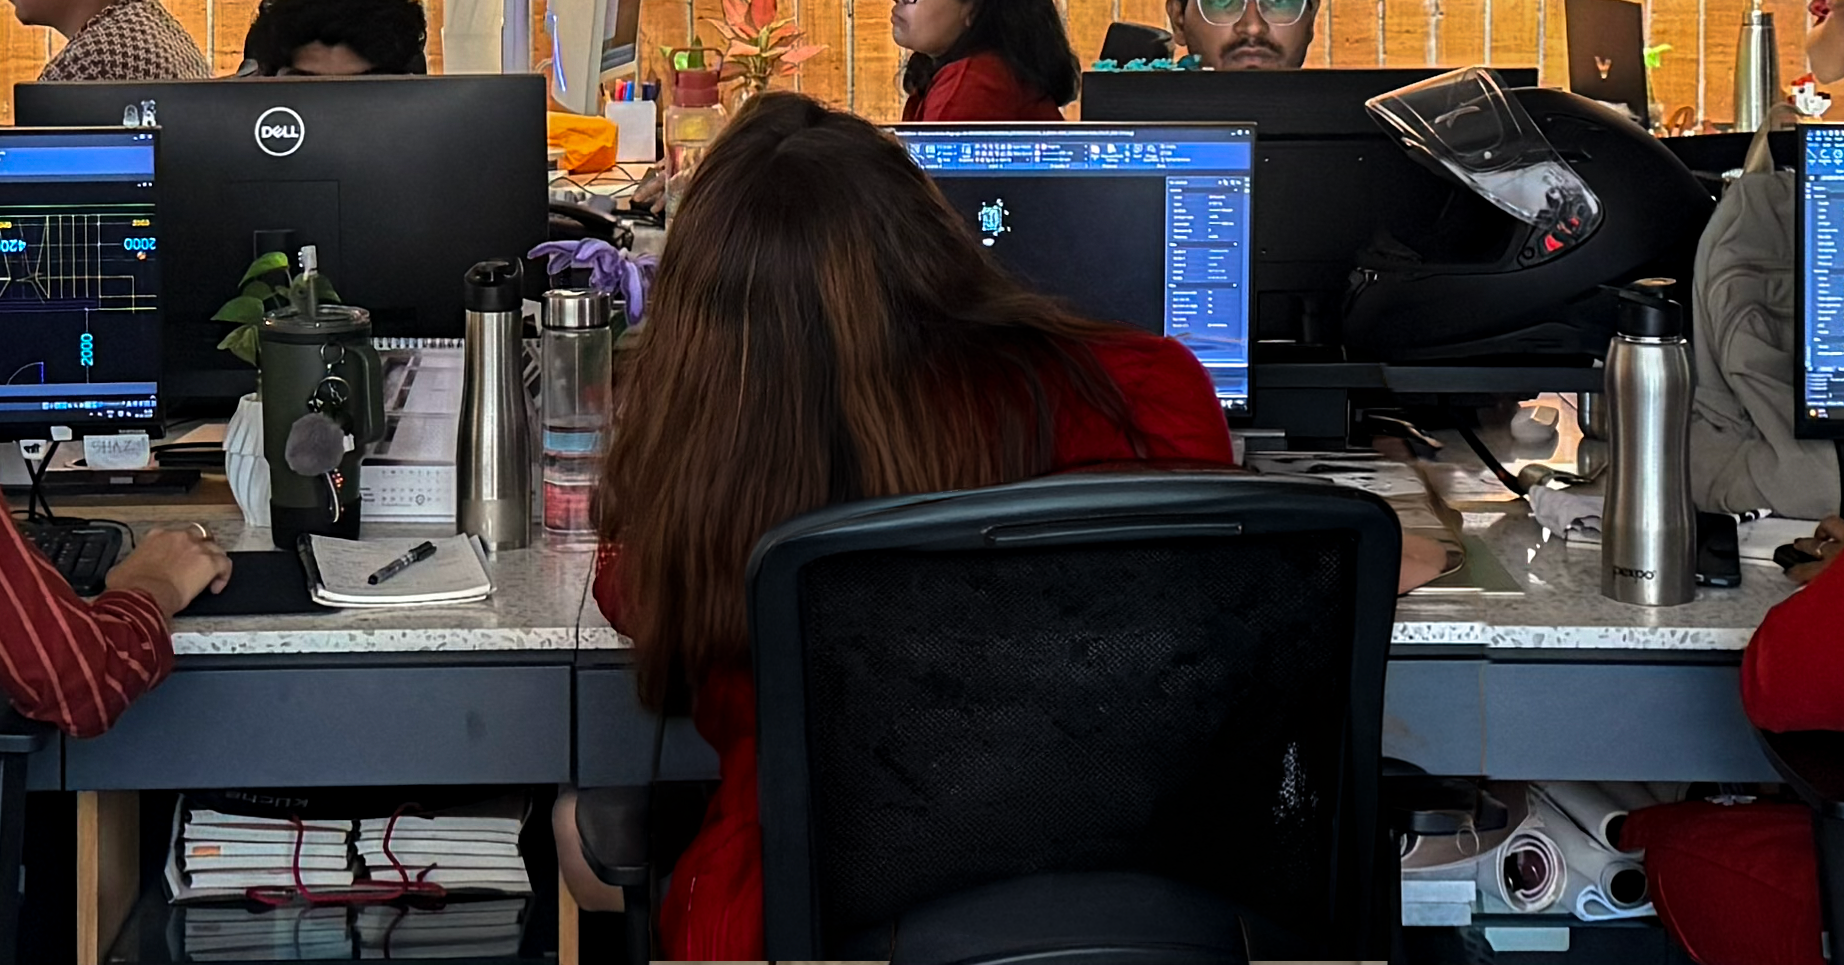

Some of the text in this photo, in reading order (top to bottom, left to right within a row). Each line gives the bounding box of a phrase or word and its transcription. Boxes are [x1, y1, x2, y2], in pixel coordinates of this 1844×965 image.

[261, 125, 299, 139] DELL
[123, 237, 156, 251] 2000
[80, 333, 94, 367] 2000
